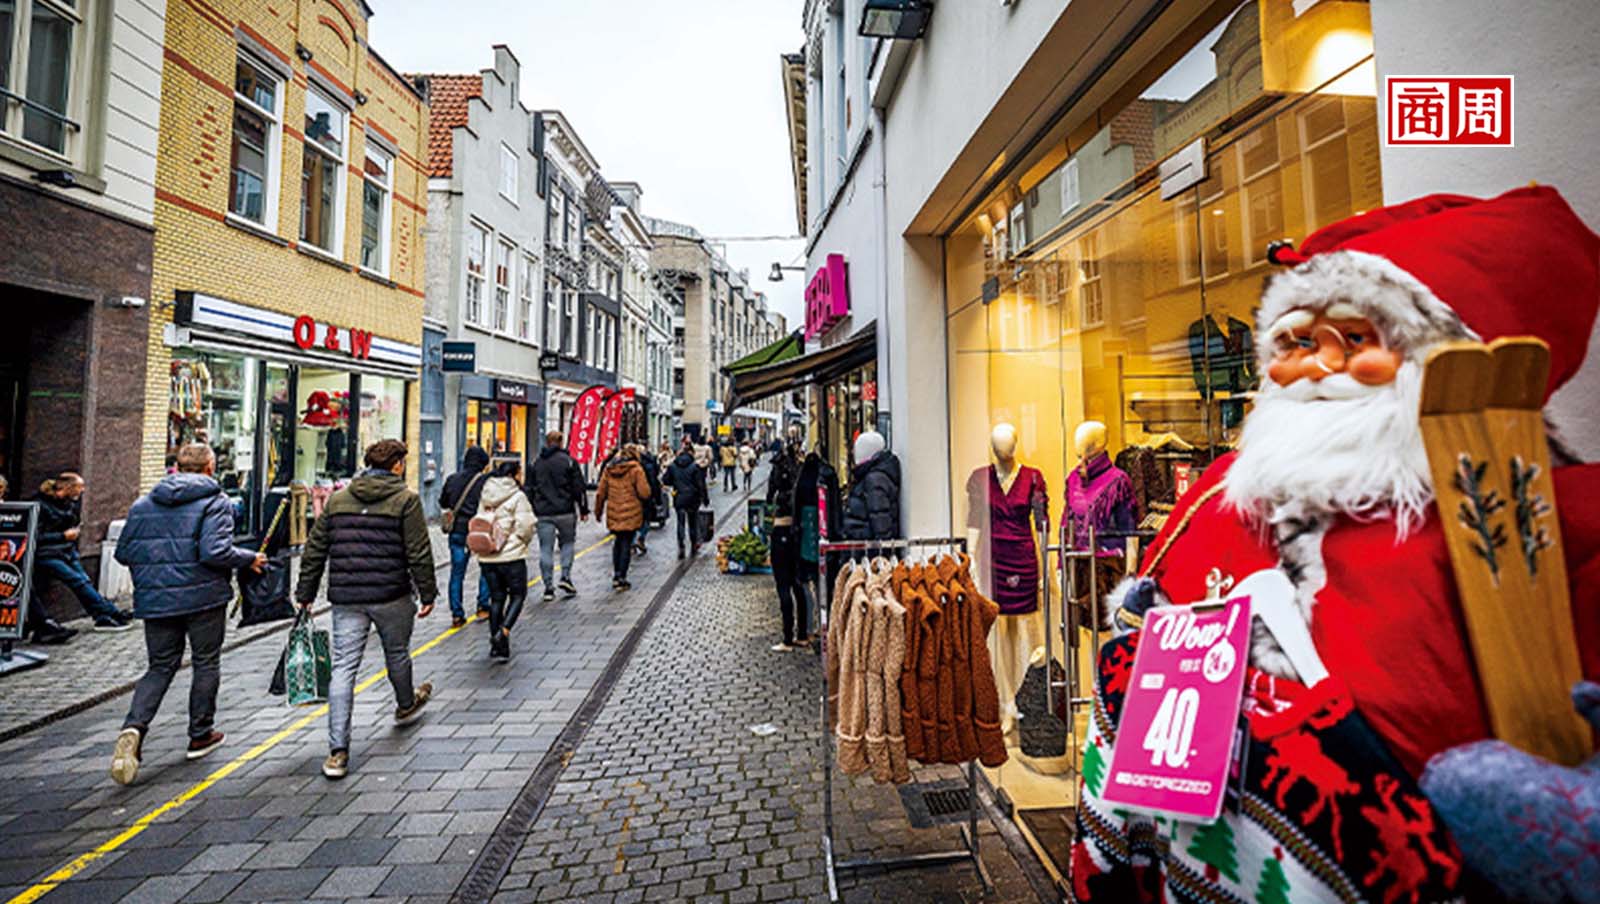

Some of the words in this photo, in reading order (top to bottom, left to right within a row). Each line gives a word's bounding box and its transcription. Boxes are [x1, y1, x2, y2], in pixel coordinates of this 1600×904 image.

[293, 314, 316, 350] O
[324, 325, 340, 351] &
[350, 327, 373, 360] W
[1152, 603, 1241, 651] Wow!
